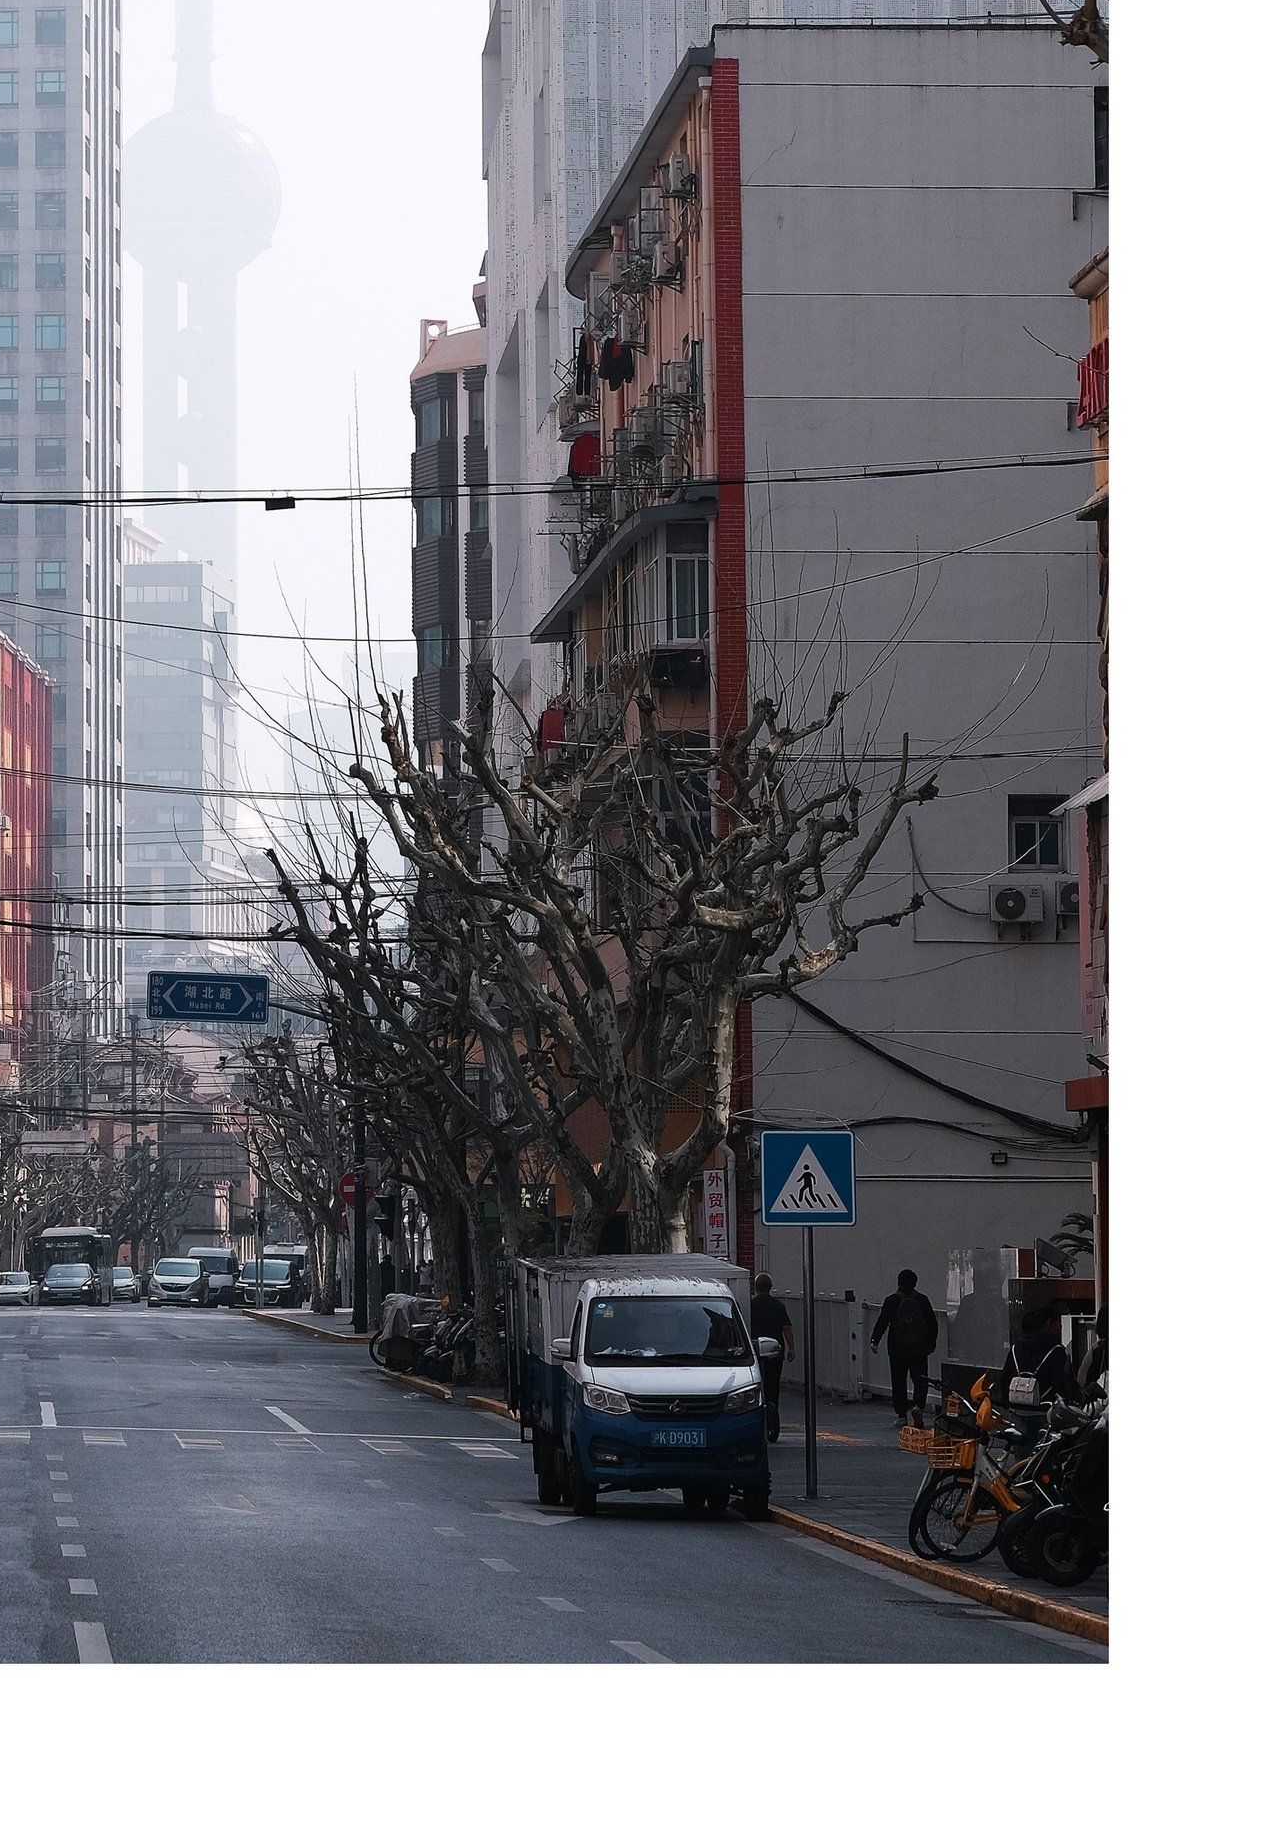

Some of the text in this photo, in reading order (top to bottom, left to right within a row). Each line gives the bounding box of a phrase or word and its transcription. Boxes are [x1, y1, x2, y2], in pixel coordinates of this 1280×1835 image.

[151, 976, 164, 986] 180
[151, 987, 161, 998] 北
[184, 985, 232, 1001] 湖北路
[151, 1005, 163, 1015] 199
[189, 1001, 227, 1011] Hubei Rd.
[251, 1011, 264, 1019] 161
[707, 1171, 726, 1249] 外贸帽子
